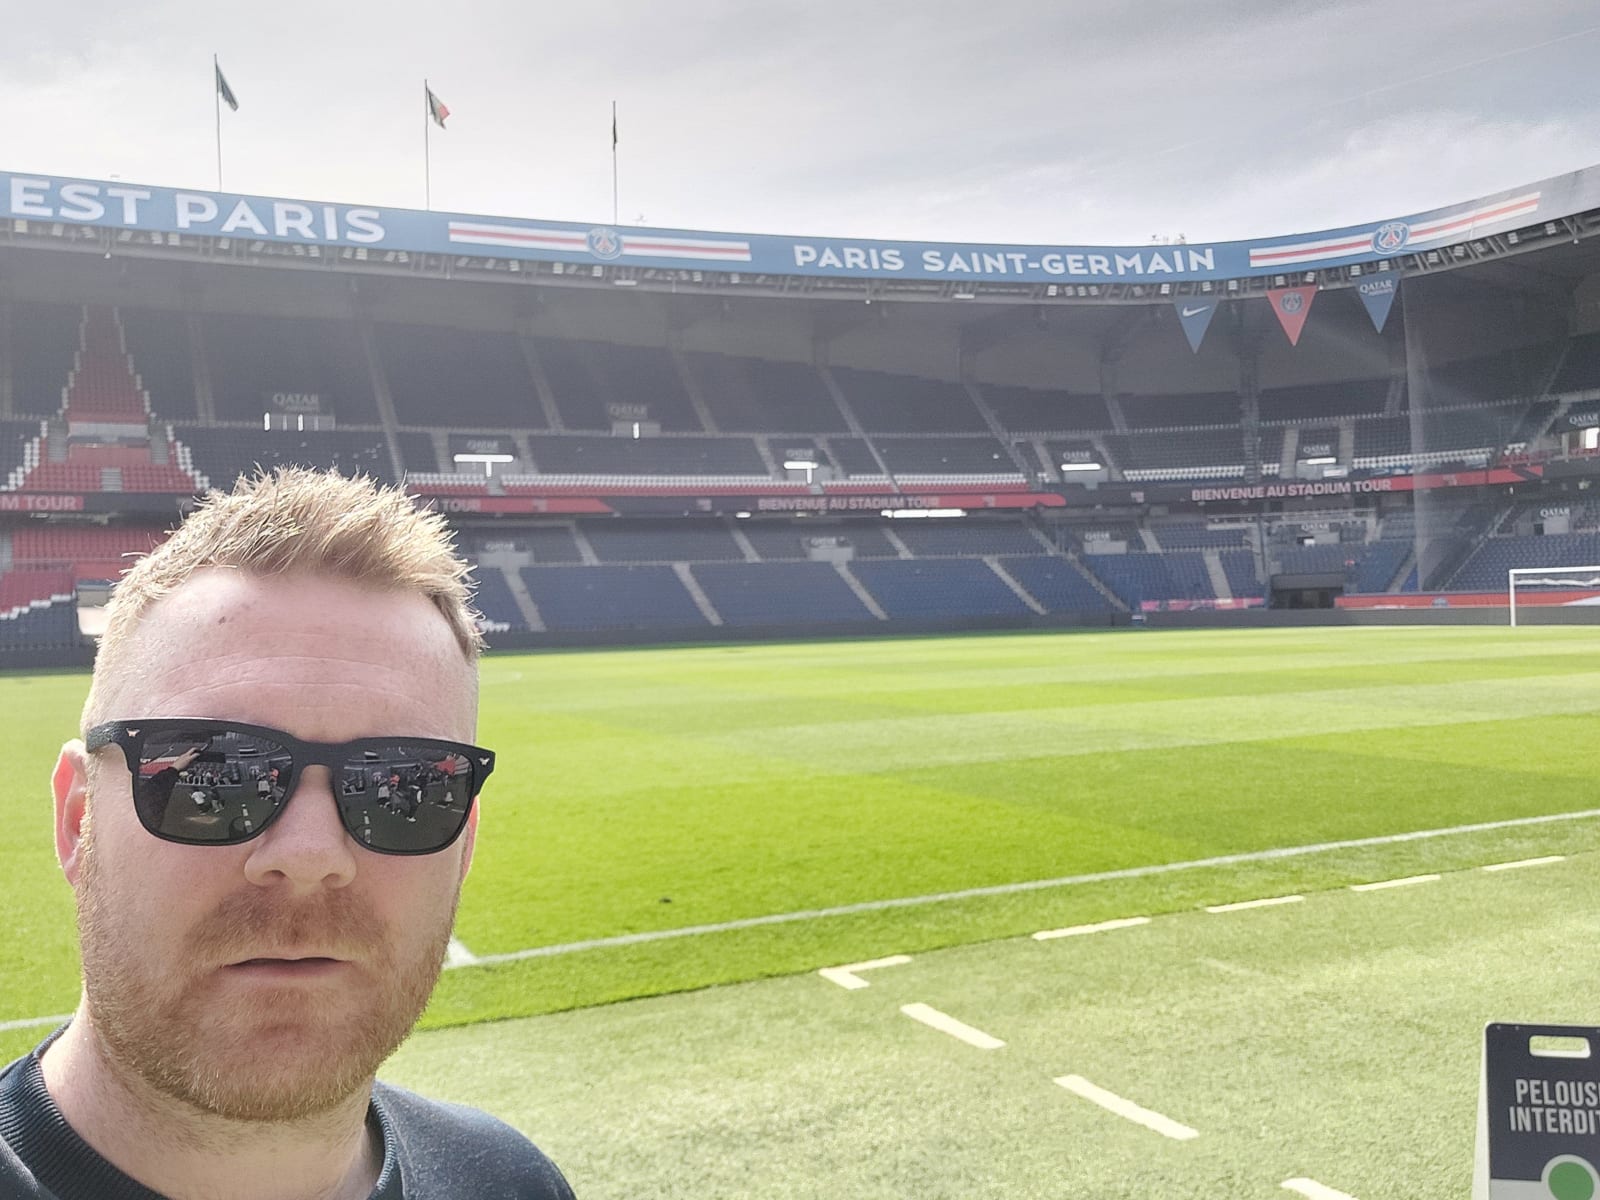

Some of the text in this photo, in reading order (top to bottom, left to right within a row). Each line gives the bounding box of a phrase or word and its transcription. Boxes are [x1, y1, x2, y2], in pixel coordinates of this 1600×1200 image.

[10, 177, 386, 243] EST PARIS
[793, 245, 1216, 276] PARIS SAINT-GERMAIN
[1360, 279, 1392, 294] QATAR
[1192, 479, 1392, 502] BIENVENUE AU STADIUM TOUR
[27, 494, 77, 511] TOUR
[441, 499, 480, 512] TOUR
[758, 496, 940, 511] BIENVENUE AU STADIUM TOUR
[1515, 1078, 1600, 1107] PELOUS
